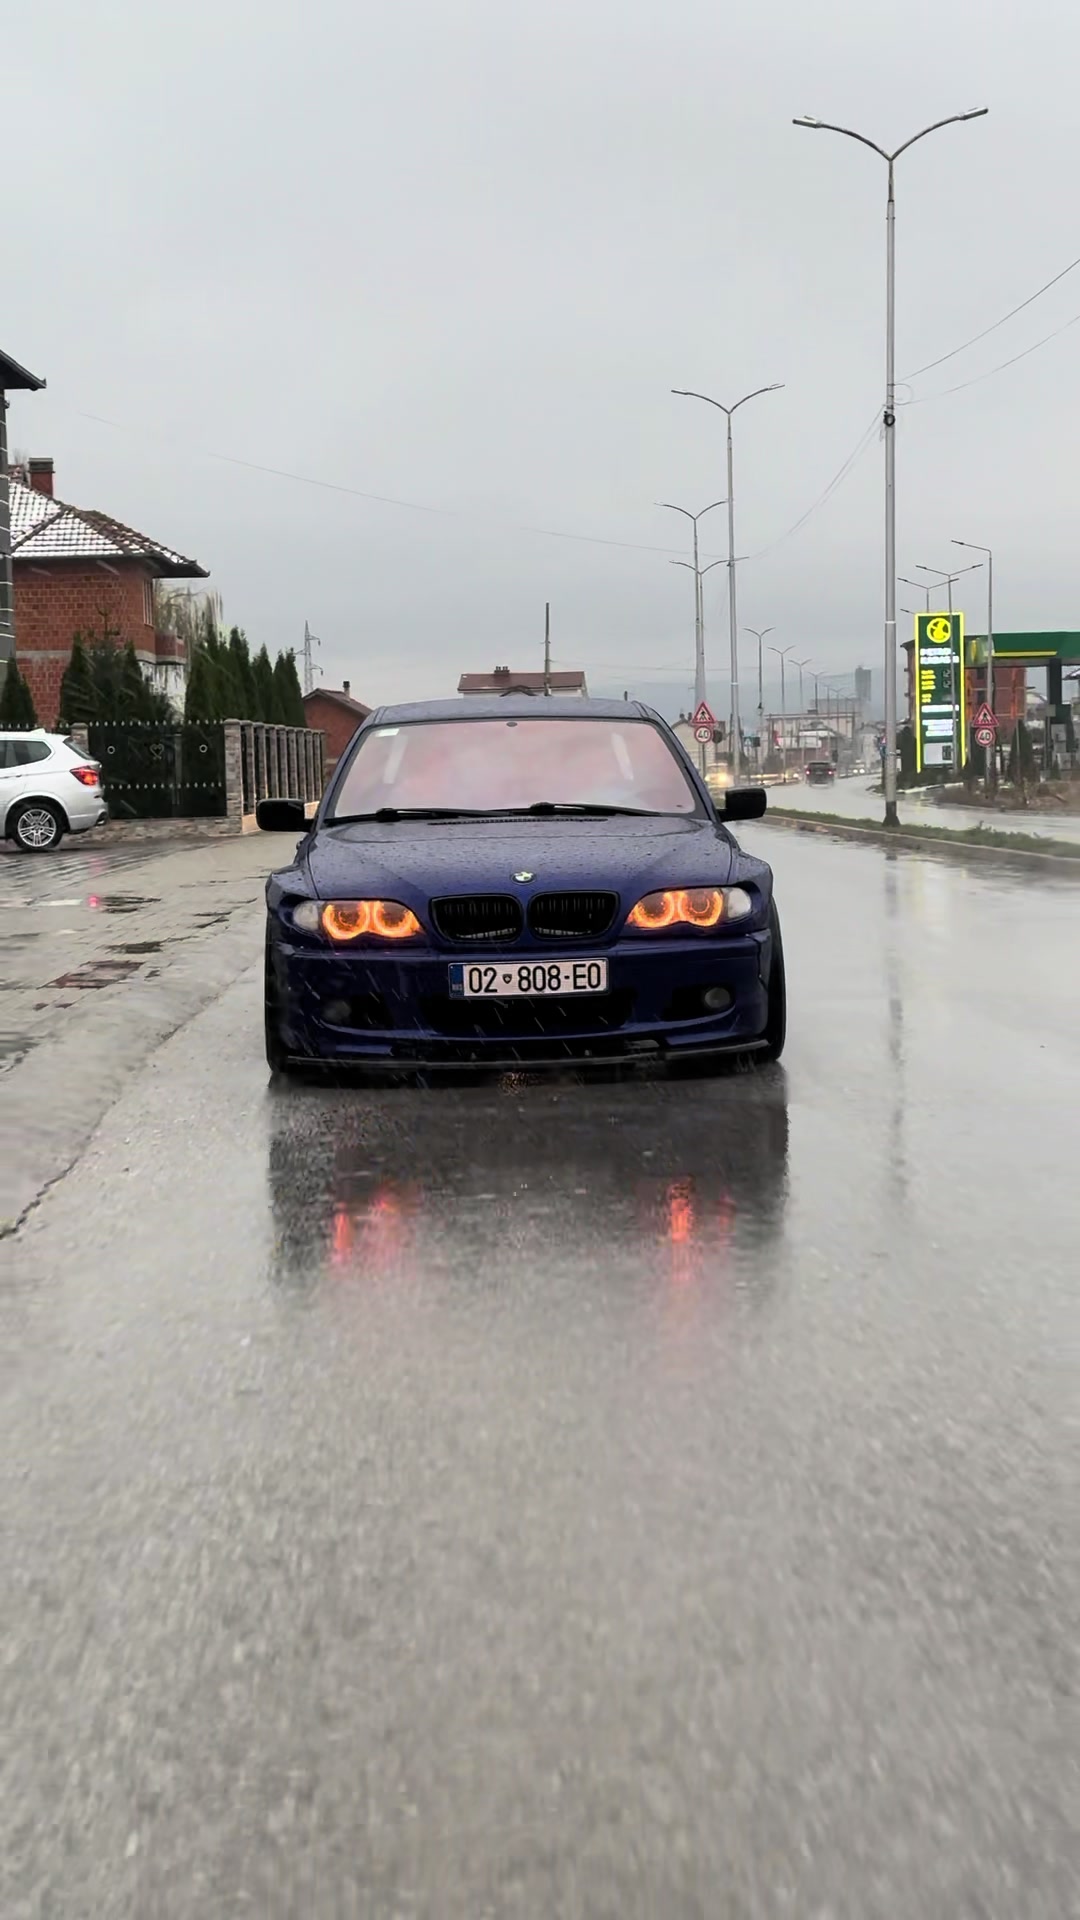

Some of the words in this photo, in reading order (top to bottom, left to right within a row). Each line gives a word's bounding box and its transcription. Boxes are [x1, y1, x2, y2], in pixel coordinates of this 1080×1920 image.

[698, 730, 709, 739] 40
[979, 731, 991, 740] 40
[468, 967, 498, 993] 02
